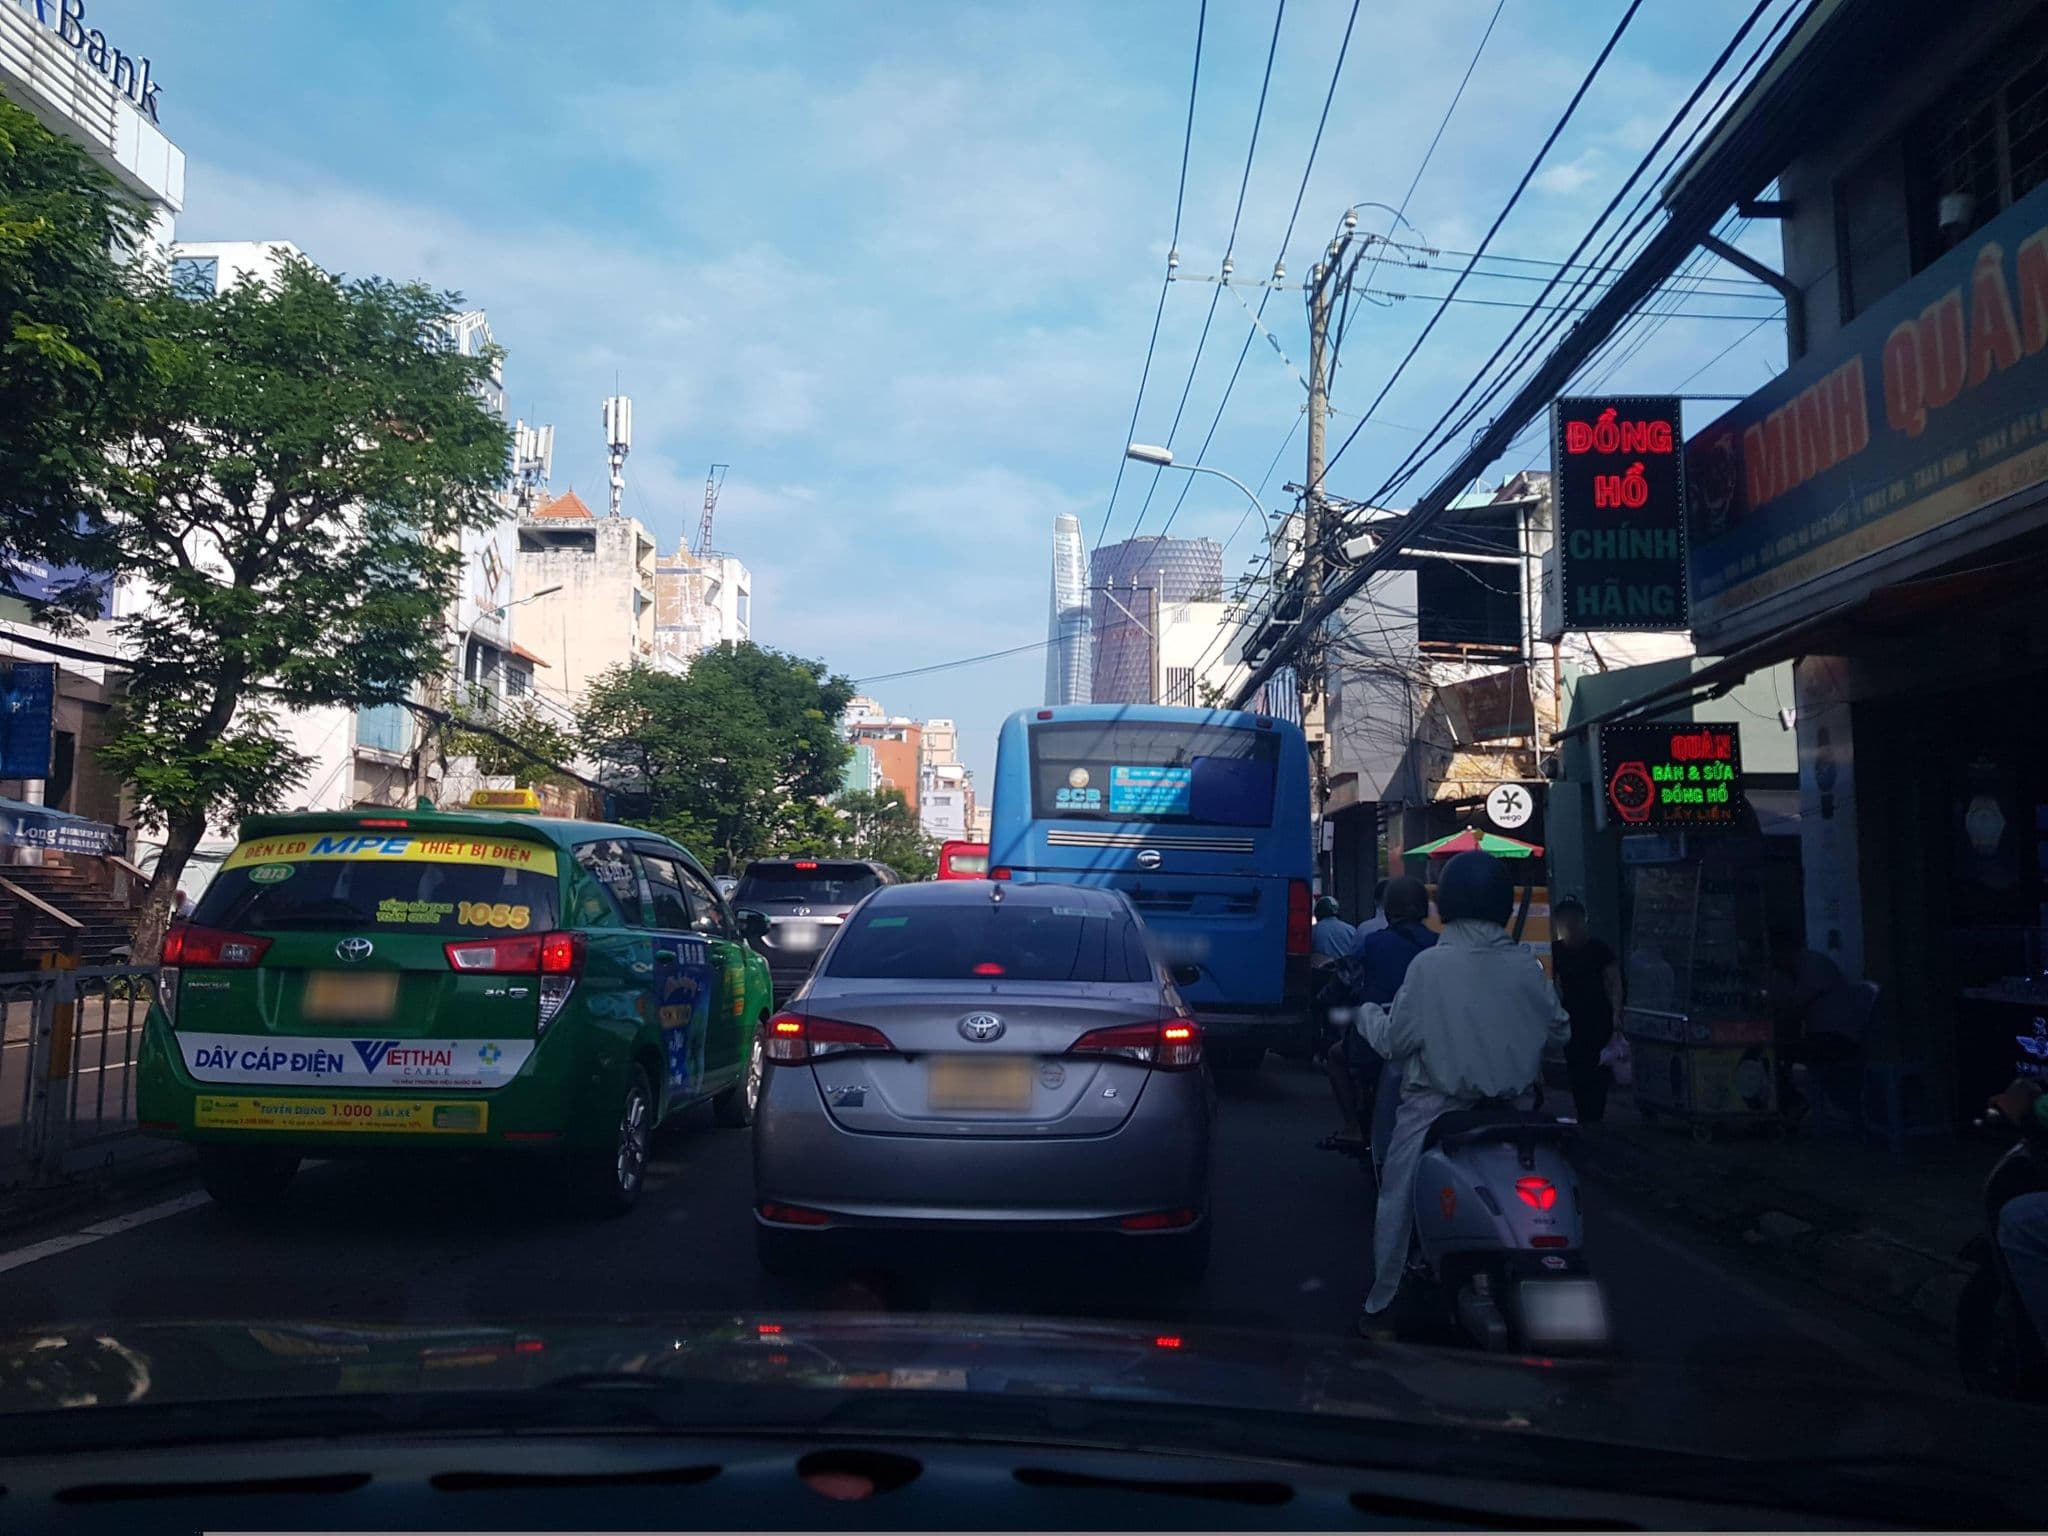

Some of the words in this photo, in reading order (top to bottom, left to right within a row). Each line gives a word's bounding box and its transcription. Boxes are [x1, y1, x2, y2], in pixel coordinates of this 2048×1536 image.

[1566, 407, 1673, 454] ĐỒNG
[1743, 353, 1870, 512] MINH
[1594, 461, 1648, 508] HỒ
[1568, 520, 1677, 560] CHÍNH
[1576, 576, 1675, 617] HÃNG
[1652, 762, 1684, 781] BÁN
[1687, 765, 1700, 780] &
[1703, 760, 1735, 781] SỬA
[1056, 787, 1101, 802] SCB
[1661, 782, 1704, 804] ĐỒNG
[1706, 782, 1729, 803] HỒ
[15, 817, 57, 845] Long
[1499, 814, 1522, 822] wego
[244, 843, 274, 859] ĐÈN
[277, 841, 306, 855] LED
[310, 836, 413, 855] MPE
[419, 839, 466, 856] THIẾT
[470, 842, 487, 860] BỊ
[492, 844, 531, 862] ĐIỆN
[457, 901, 530, 930] 1055
[195, 1045, 238, 1069] DÂY
[240, 1046, 287, 1071] CÁP
[289, 1049, 344, 1077] ĐIỆN
[1102, 1088, 1118, 1099] E
[331, 1104, 373, 1117] 1.000
